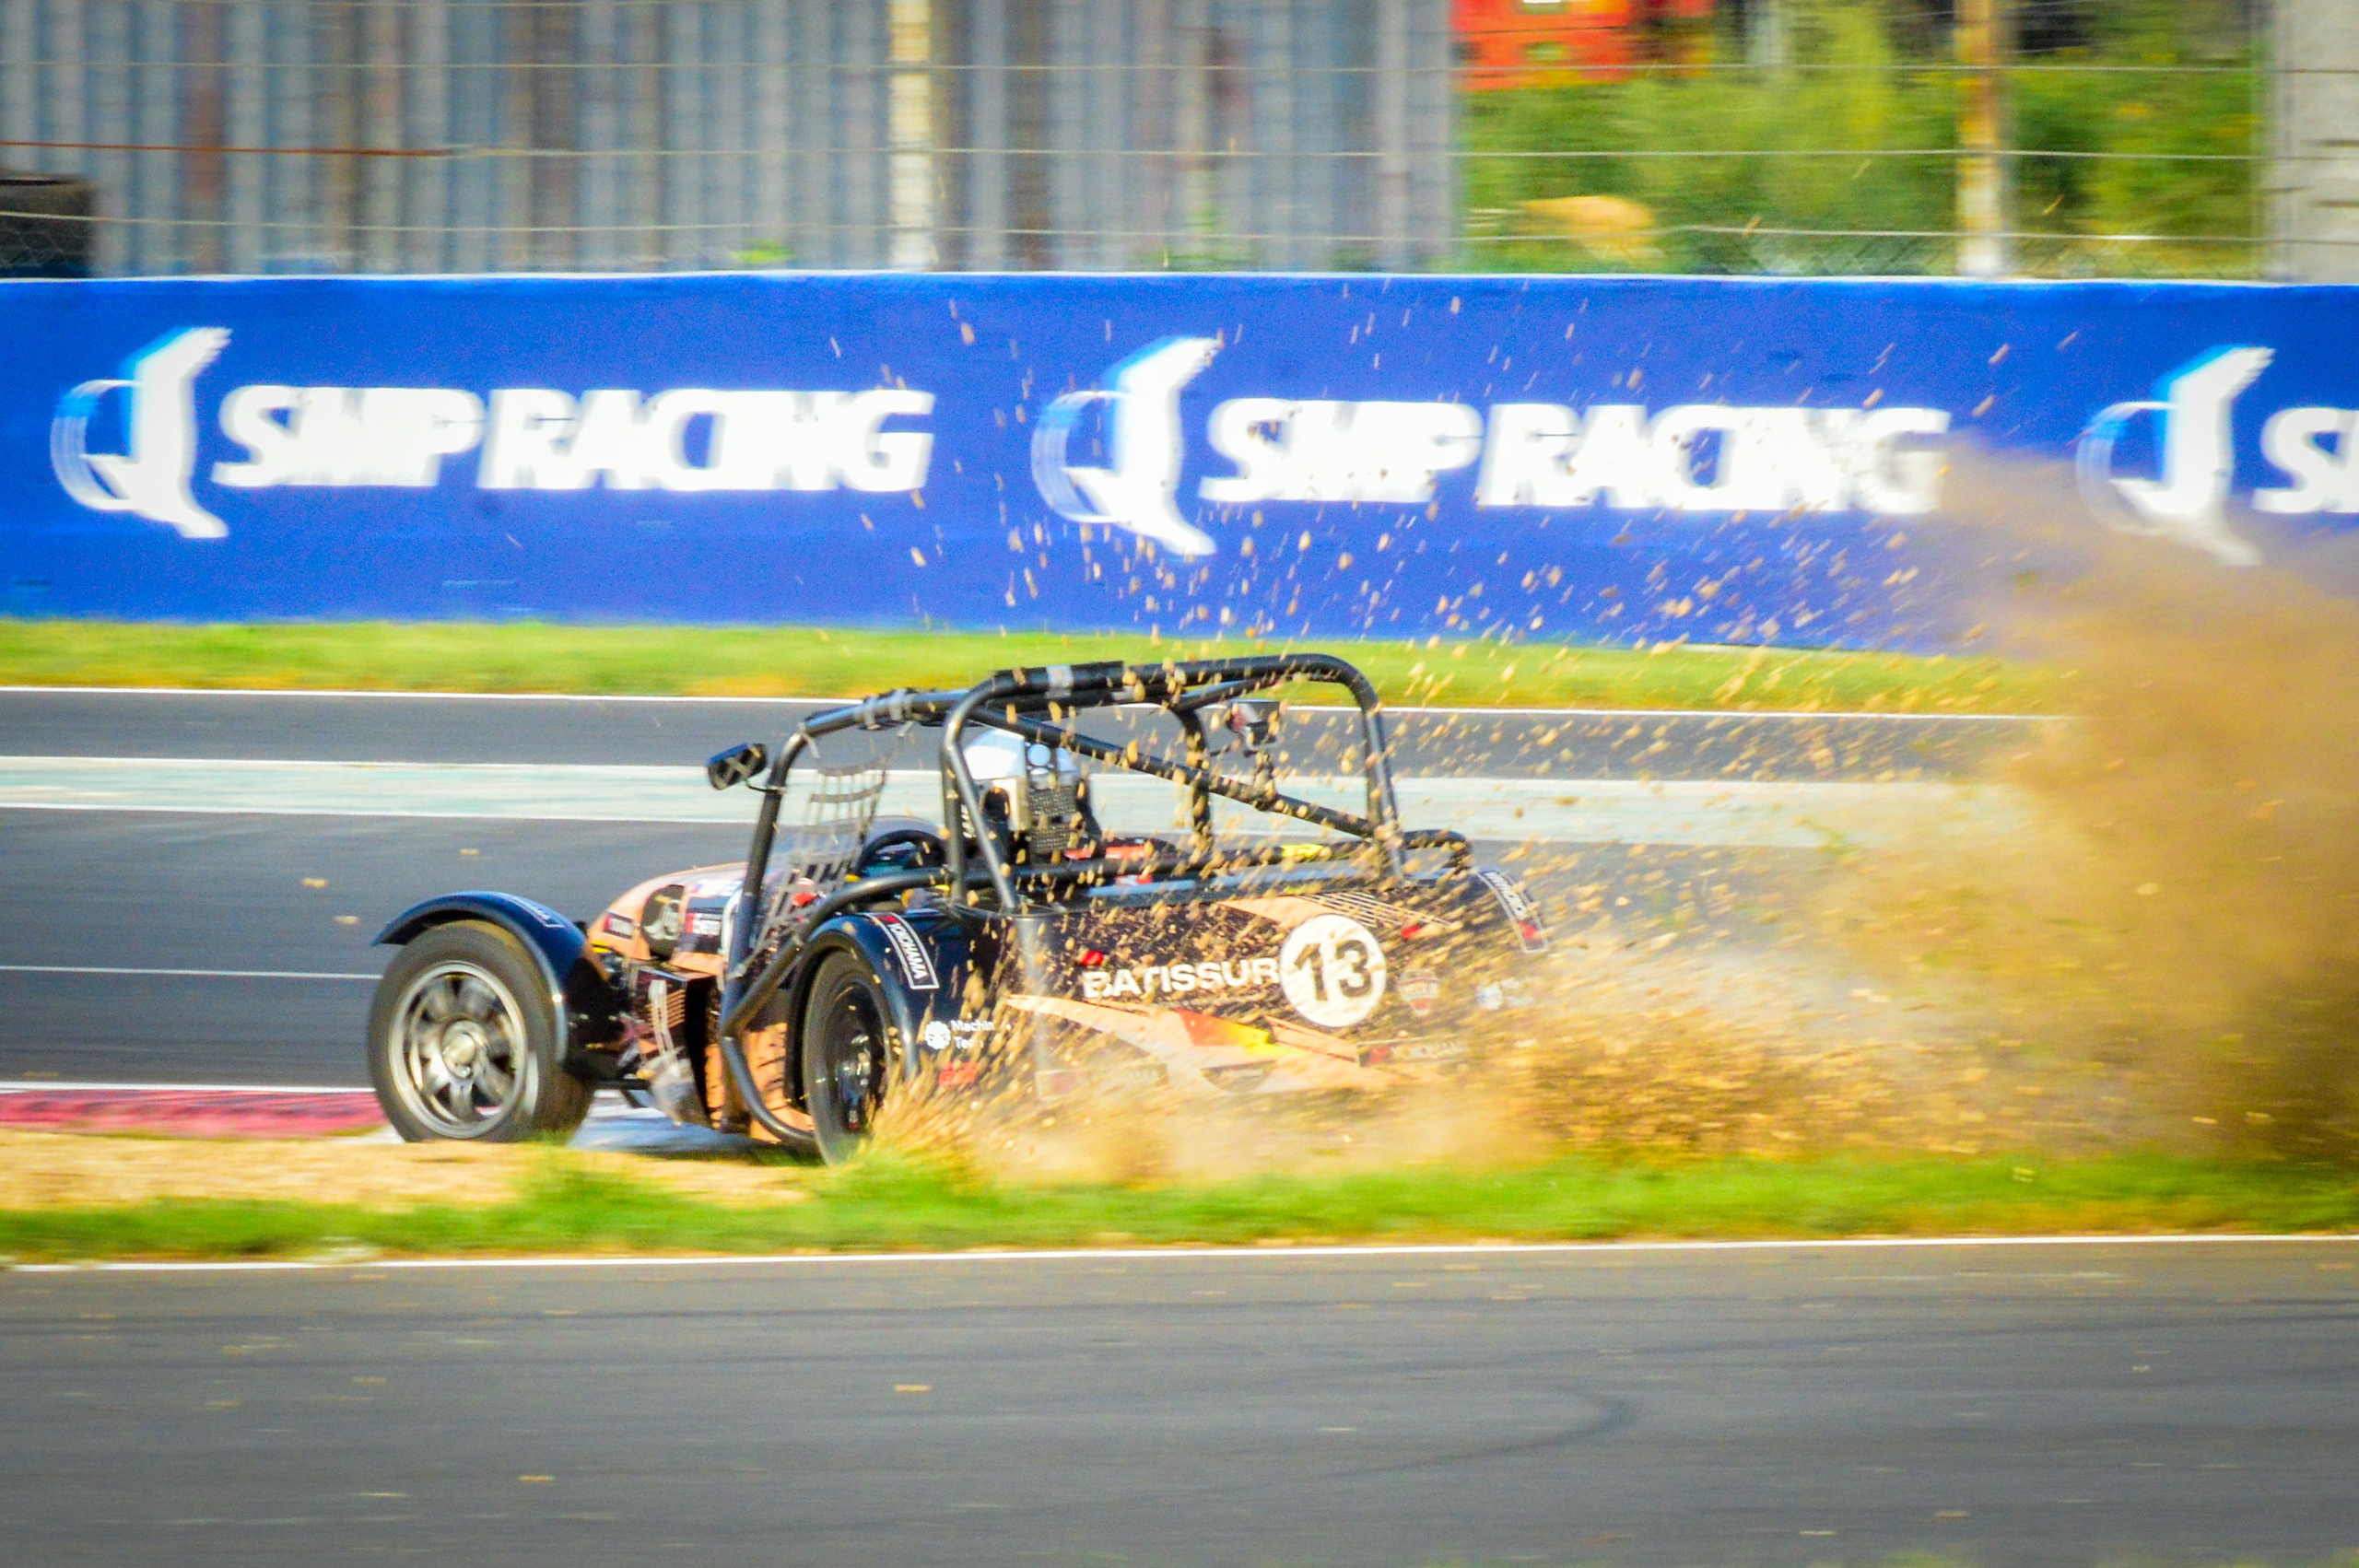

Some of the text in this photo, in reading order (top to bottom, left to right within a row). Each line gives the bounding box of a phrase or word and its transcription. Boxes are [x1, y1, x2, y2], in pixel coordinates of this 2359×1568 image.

[210, 385, 935, 491] SMP RACING
[1200, 398, 1951, 514] SMP RACING
[886, 923, 929, 979] YOKOHAMA
[1082, 957, 1280, 999] BATISSUR
[1294, 940, 1373, 1001] 13
